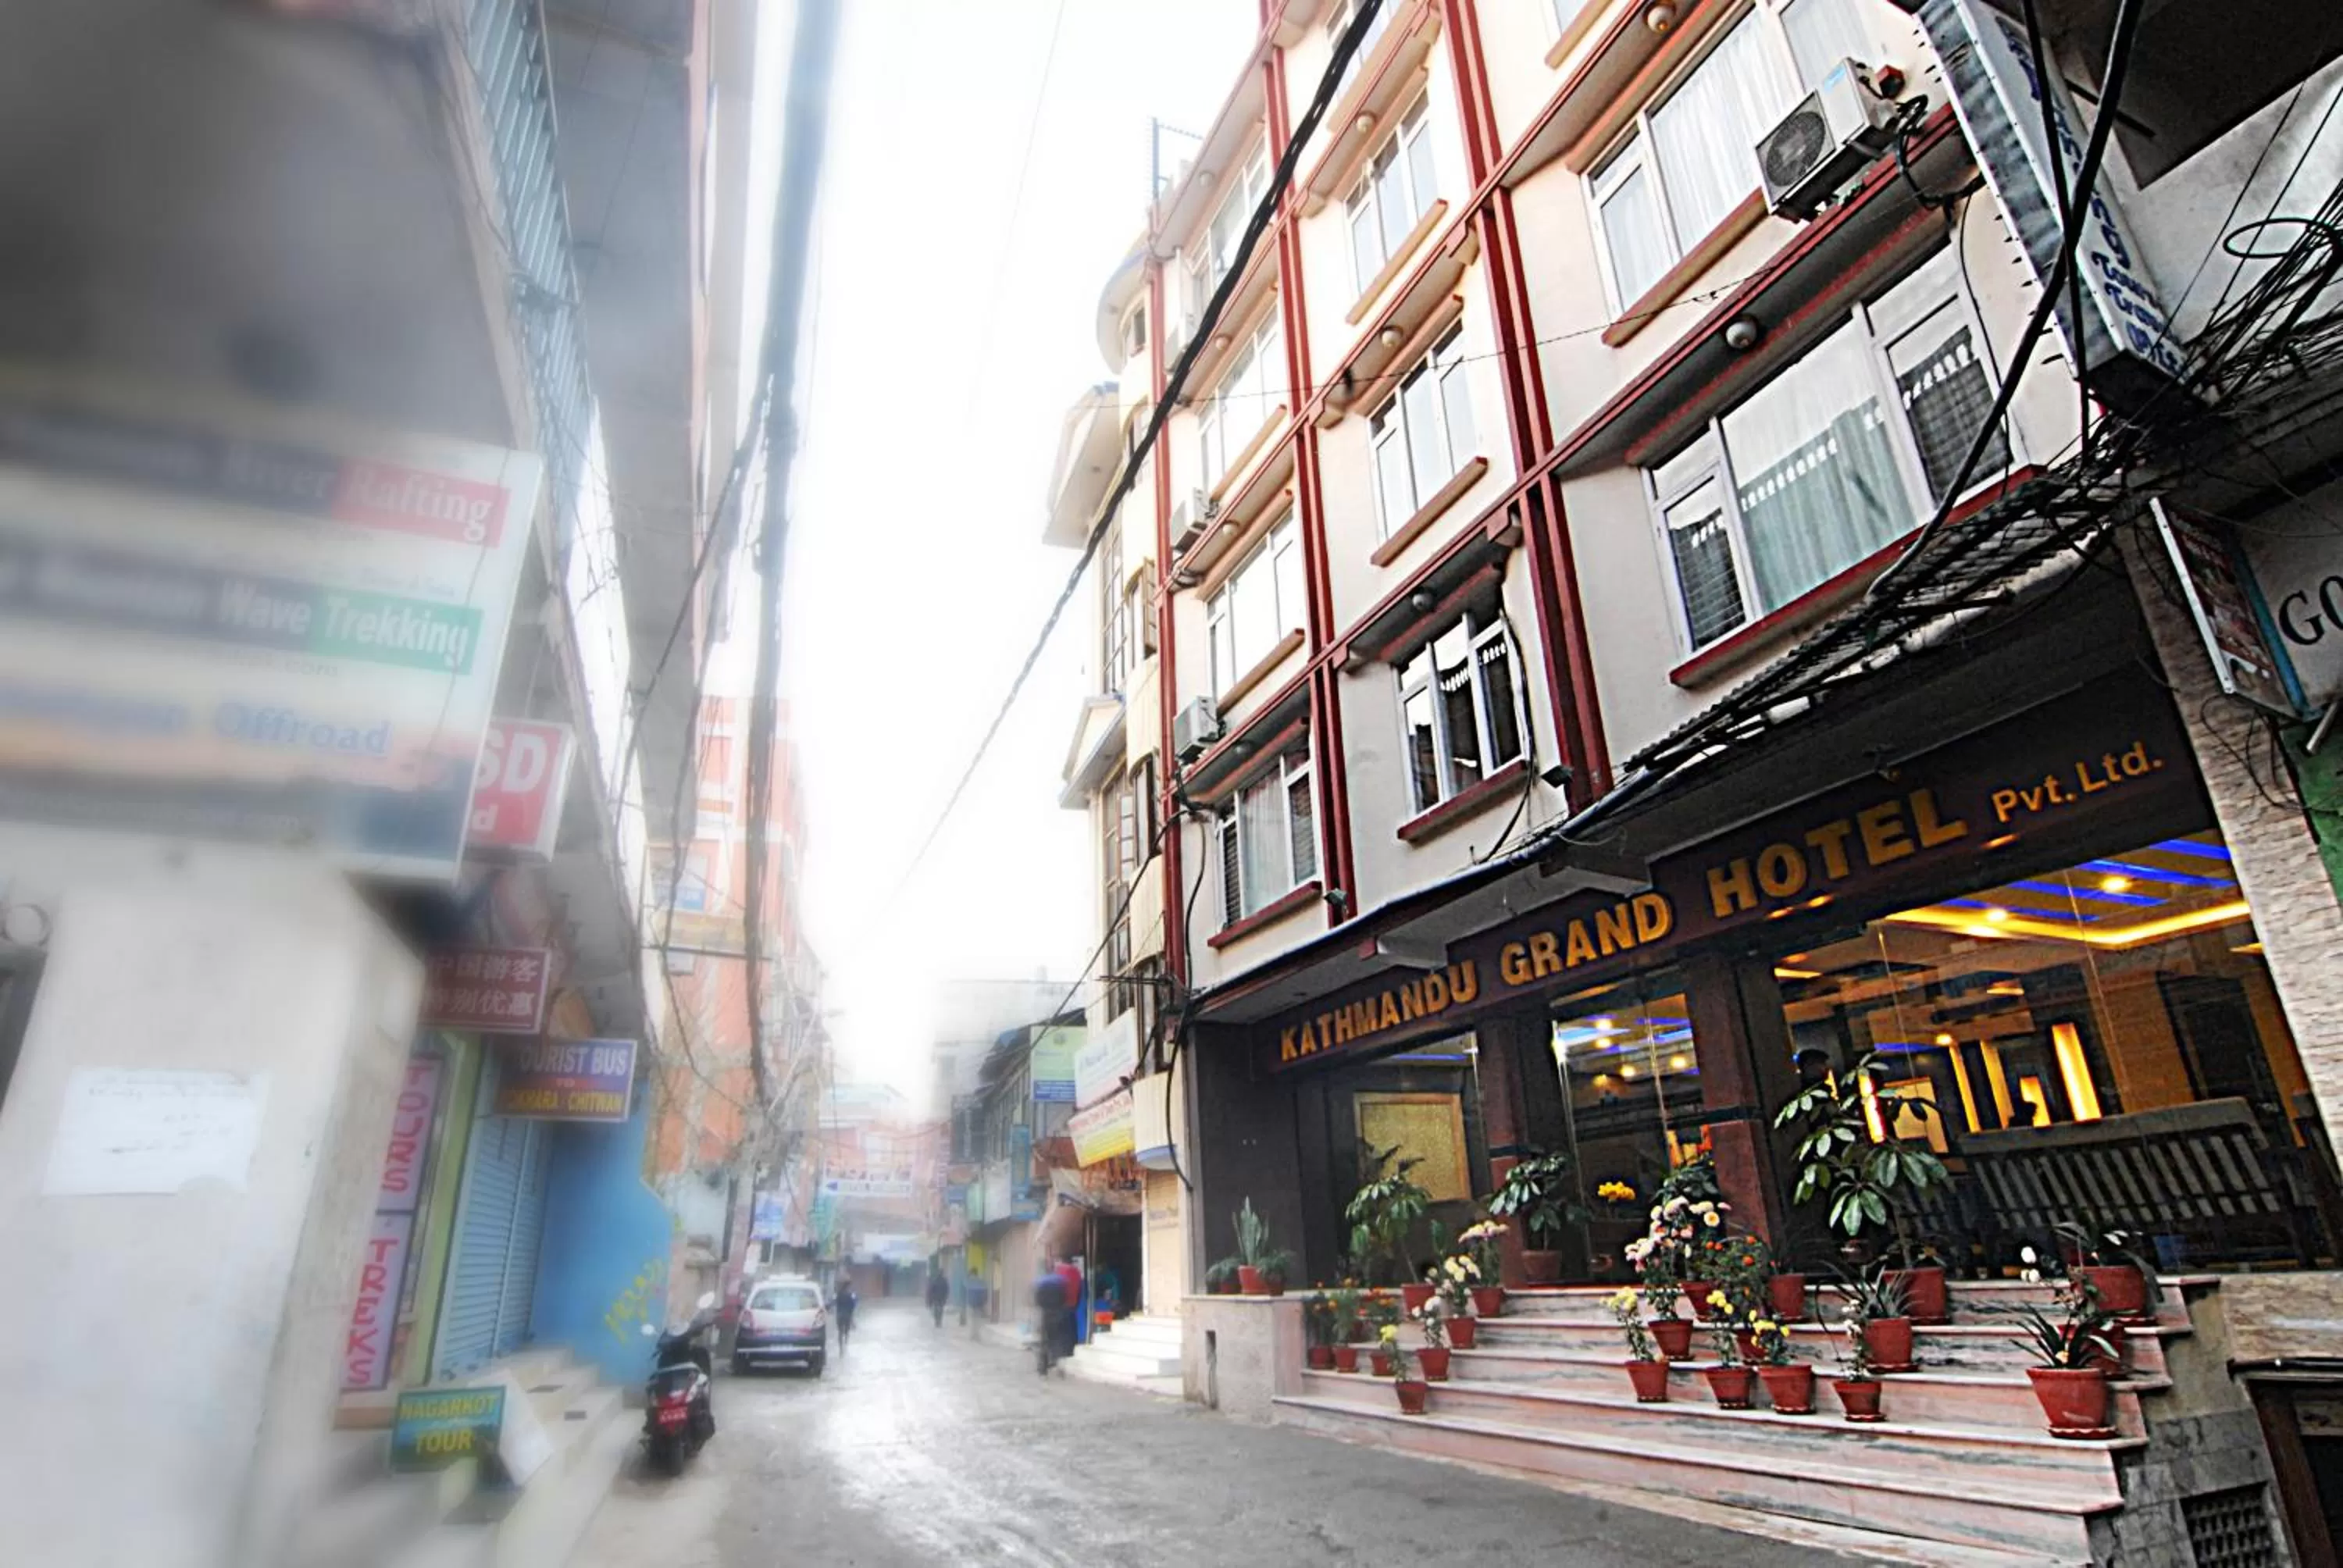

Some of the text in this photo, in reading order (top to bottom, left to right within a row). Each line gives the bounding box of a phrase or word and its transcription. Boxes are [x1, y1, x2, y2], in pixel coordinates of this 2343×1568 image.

[348, 465, 492, 543] Rafting
[325, 596, 469, 669] Trekking
[215, 700, 390, 756] Offroad
[1280, 741, 2165, 1061] KATHMANDU GRAND HOTEL Pvt. Ltd.
[509, 1043, 628, 1076] OURIST BUS
[381, 1065, 433, 1192] TOURS
[346, 1237, 400, 1384] TREKS
[414, 1427, 473, 1456] TOUR
